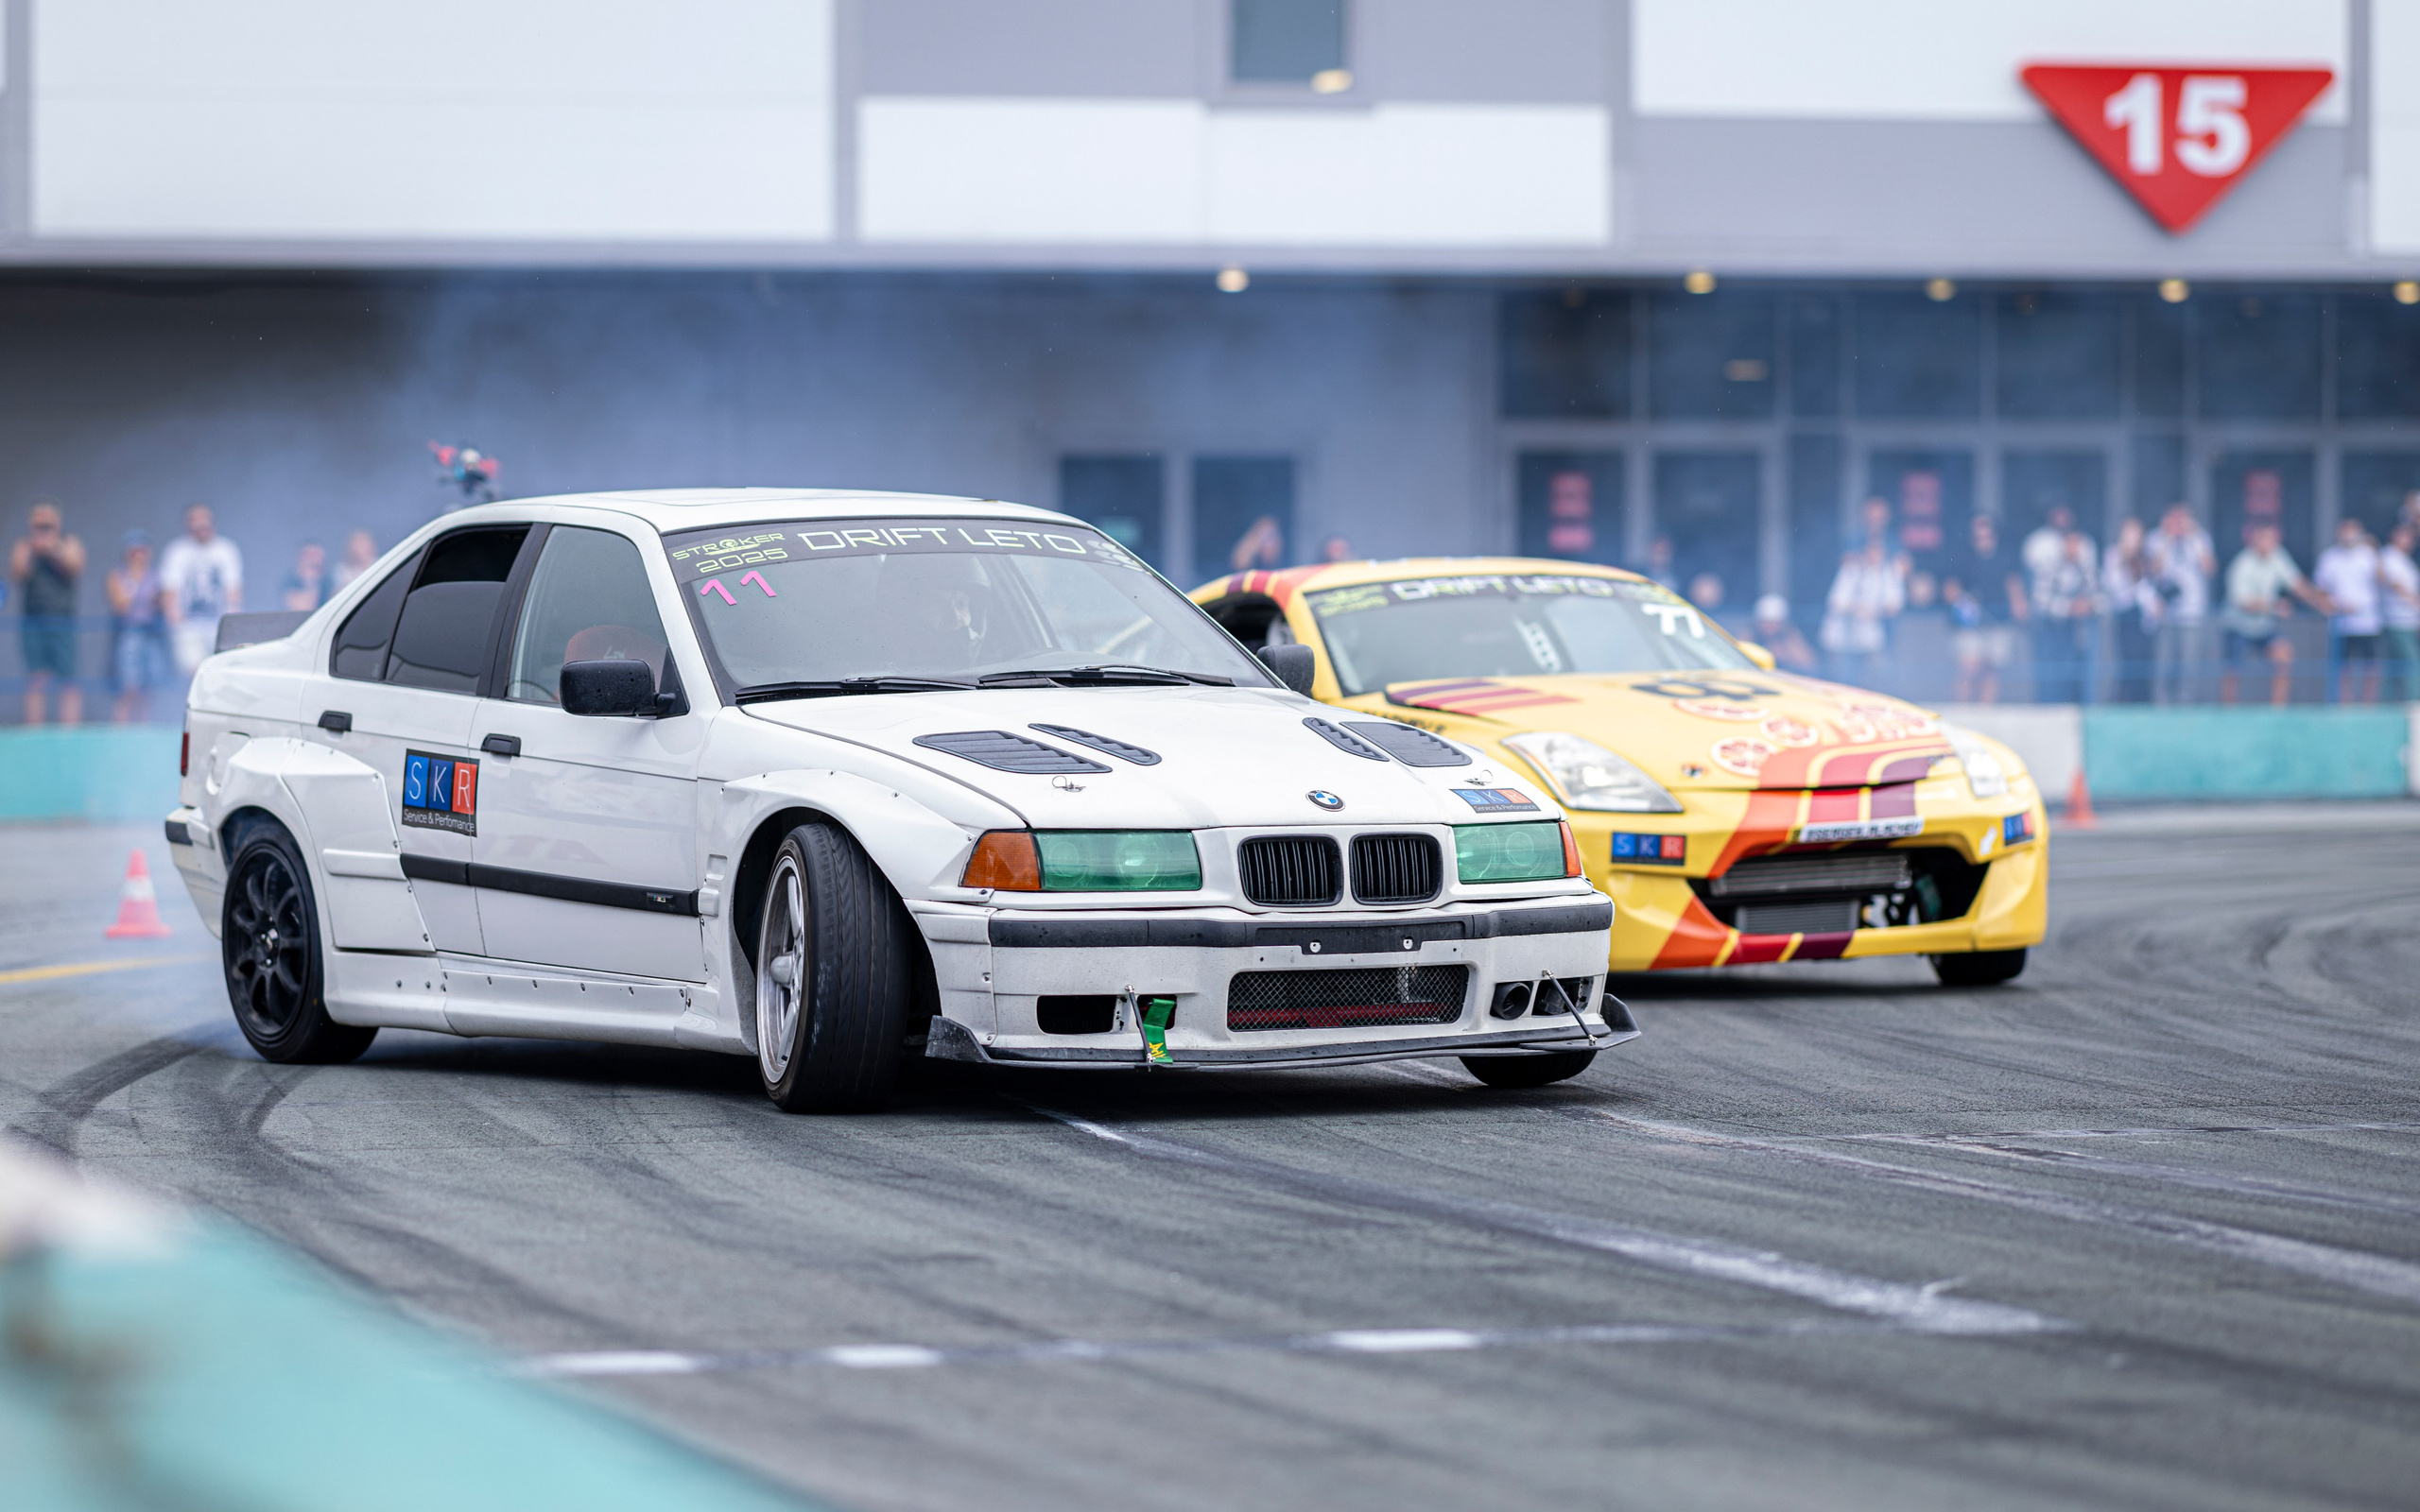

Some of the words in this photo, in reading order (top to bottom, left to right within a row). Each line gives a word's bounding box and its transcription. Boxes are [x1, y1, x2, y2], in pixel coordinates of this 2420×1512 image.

[2102, 72, 2252, 178] 15
[797, 527, 948, 551] DRIFT
[958, 527, 1087, 555] LETO
[696, 547, 788, 574] 2025
[700, 570, 777, 606] 11
[1391, 575, 1508, 601] DRIFT
[1640, 602, 1706, 640] 77
[409, 761, 470, 808] SKR
[1461, 790, 1524, 803] SKR
[404, 808, 427, 824] Service
[427, 812, 434, 825] &
[1615, 833, 1681, 856] SKR
